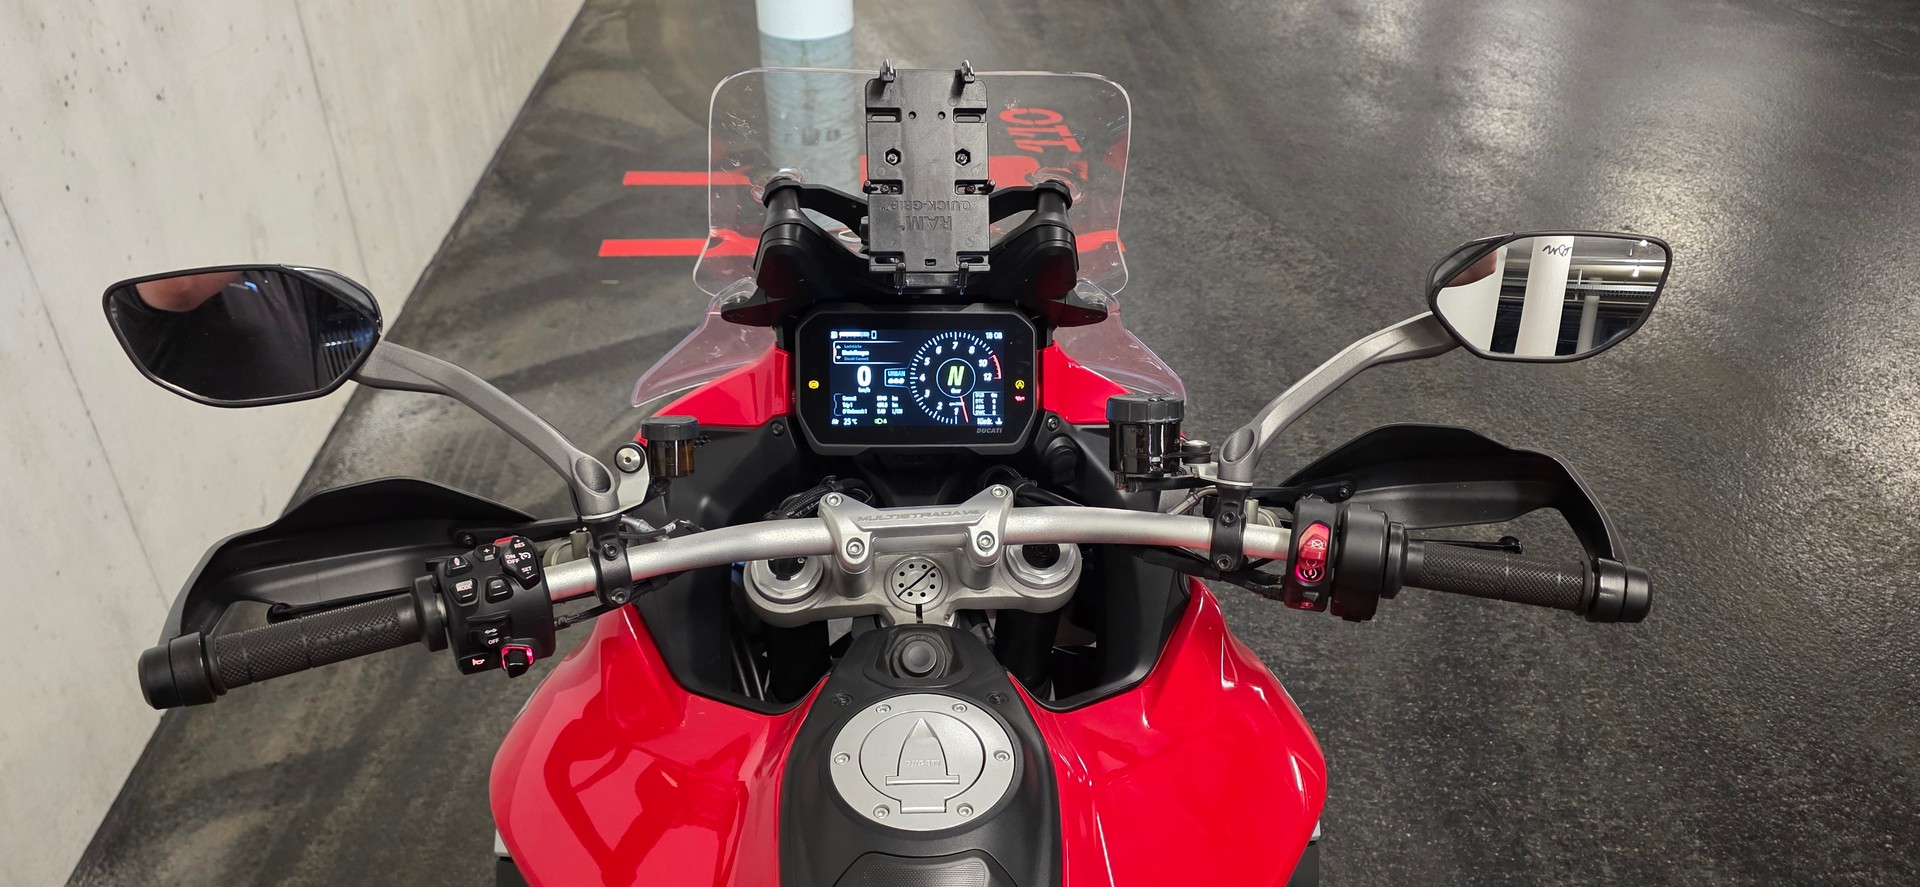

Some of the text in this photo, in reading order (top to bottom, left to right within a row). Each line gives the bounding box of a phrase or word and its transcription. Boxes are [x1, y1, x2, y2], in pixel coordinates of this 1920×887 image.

[935, 346, 942, 354] 6
[952, 341, 959, 350] 7
[968, 346, 976, 354] 8
[924, 357, 931, 366] 5
[978, 359, 988, 367] 10
[857, 365, 871, 387] 0
[919, 373, 926, 382] 4
[947, 365, 965, 386] N
[983, 373, 992, 381] 12
[924, 389, 931, 398] 3
[936, 402, 943, 411] 2
[954, 407, 959, 415] 1
[857, 511, 962, 522] MULTISTRADA
[905, 759, 941, 767] DUCATI
